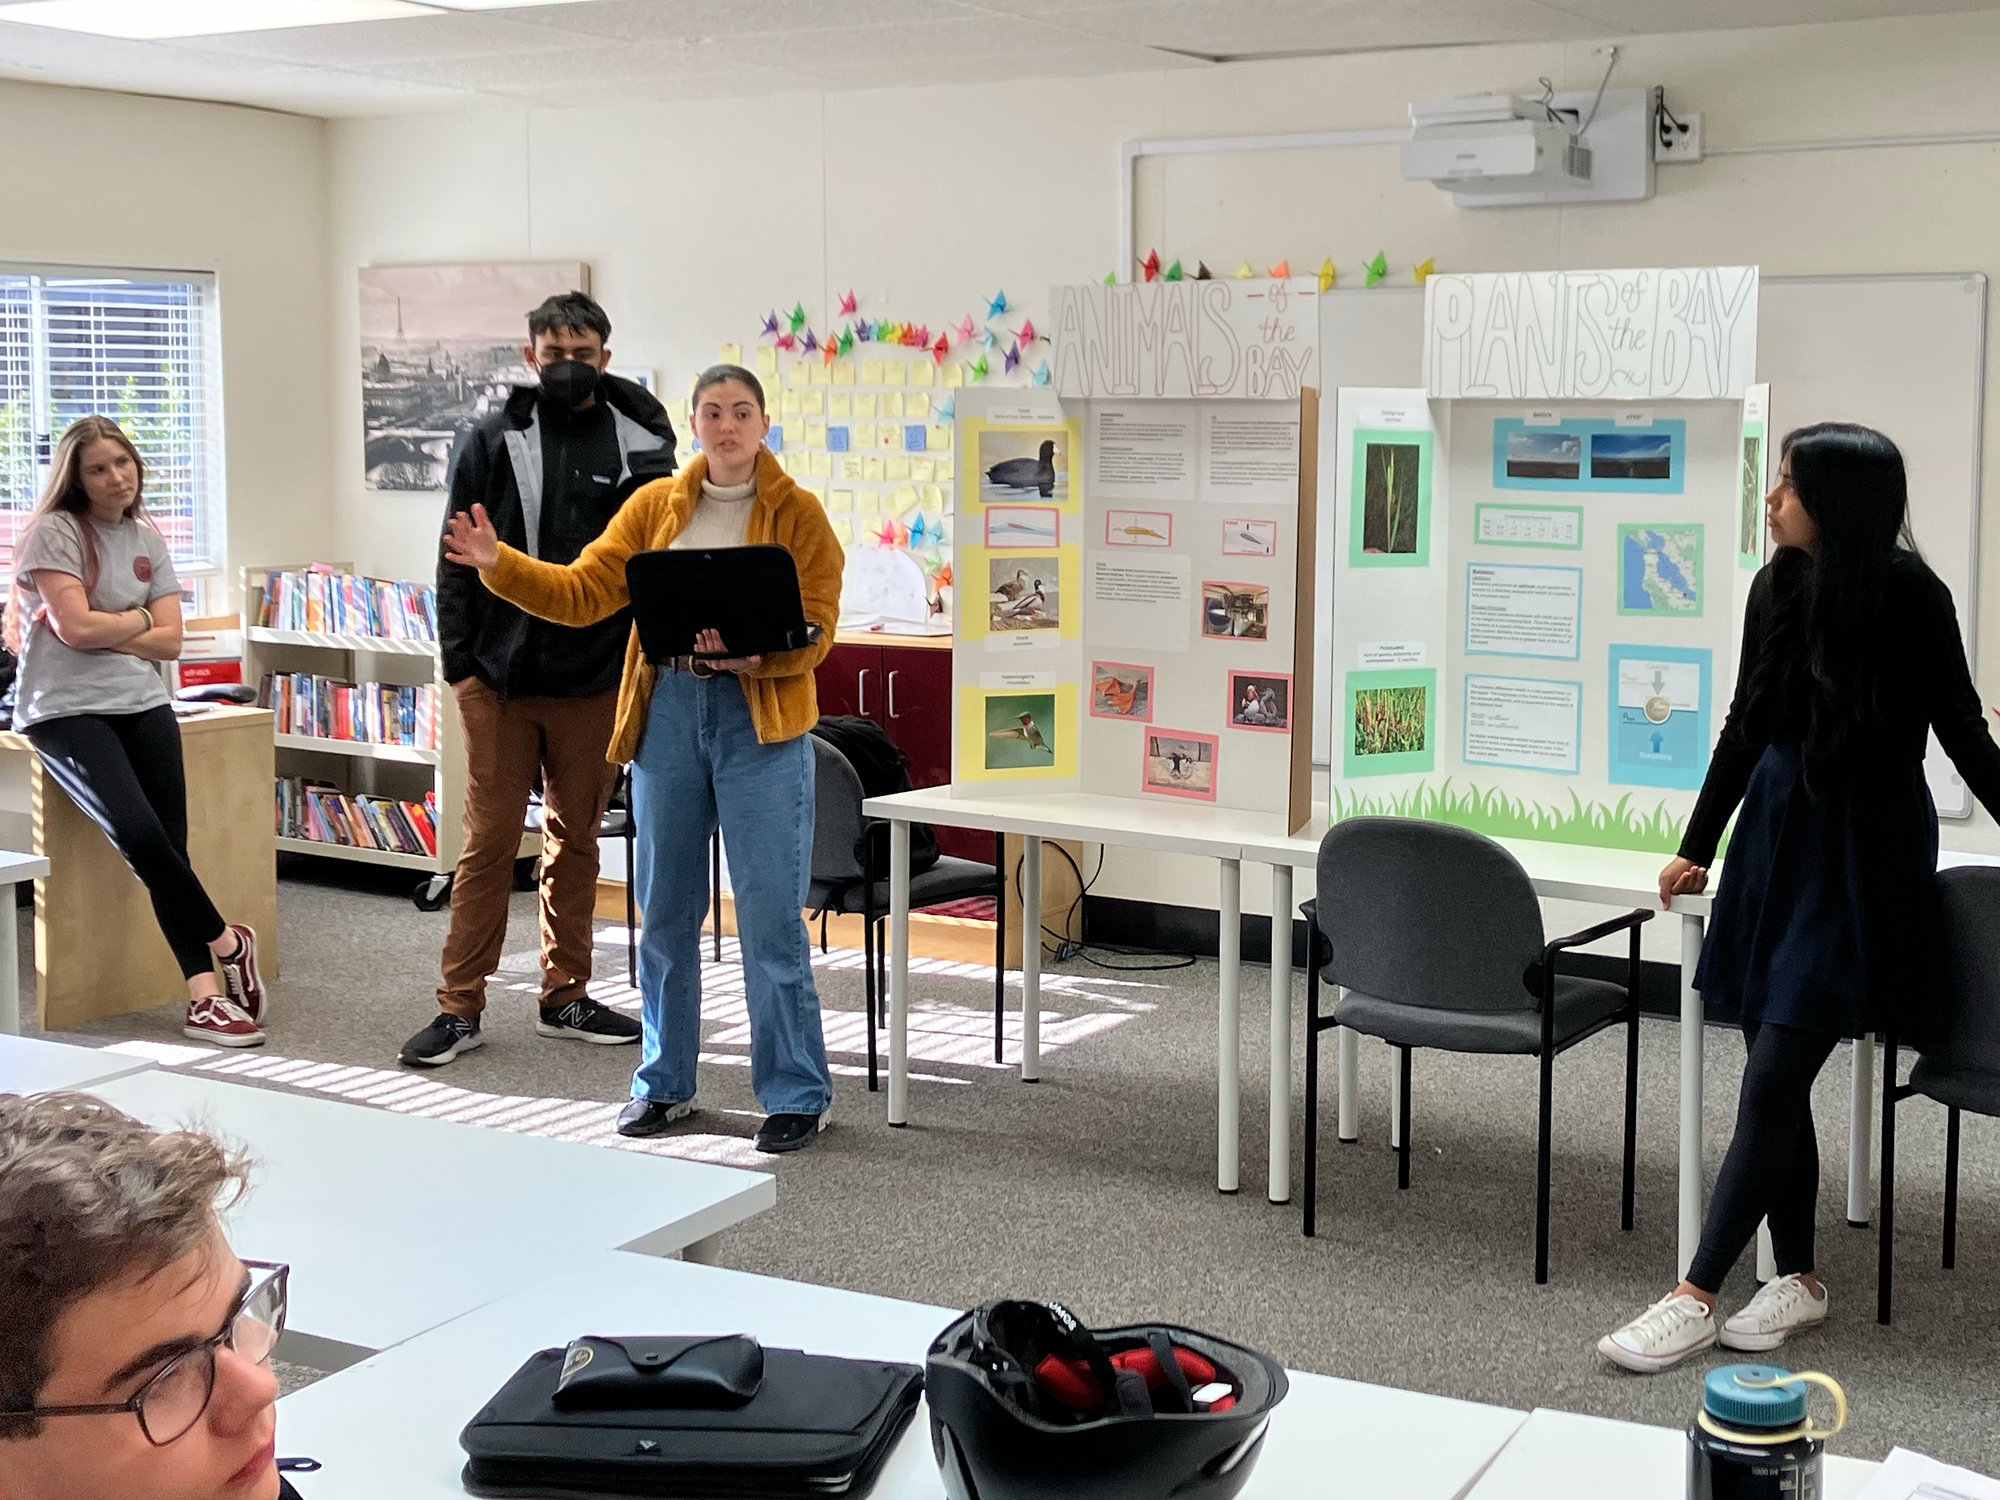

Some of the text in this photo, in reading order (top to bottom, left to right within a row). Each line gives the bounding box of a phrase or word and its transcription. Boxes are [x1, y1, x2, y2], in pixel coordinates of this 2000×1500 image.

[1268, 280, 1292, 313] of
[1621, 271, 1648, 312] of
[1053, 281, 1240, 397] ANIMALS
[1259, 316, 1295, 344] the
[1429, 272, 1618, 398] PLANTS
[1608, 317, 1648, 351] the
[1650, 266, 1755, 398] BAY
[1246, 344, 1313, 398] BAY
